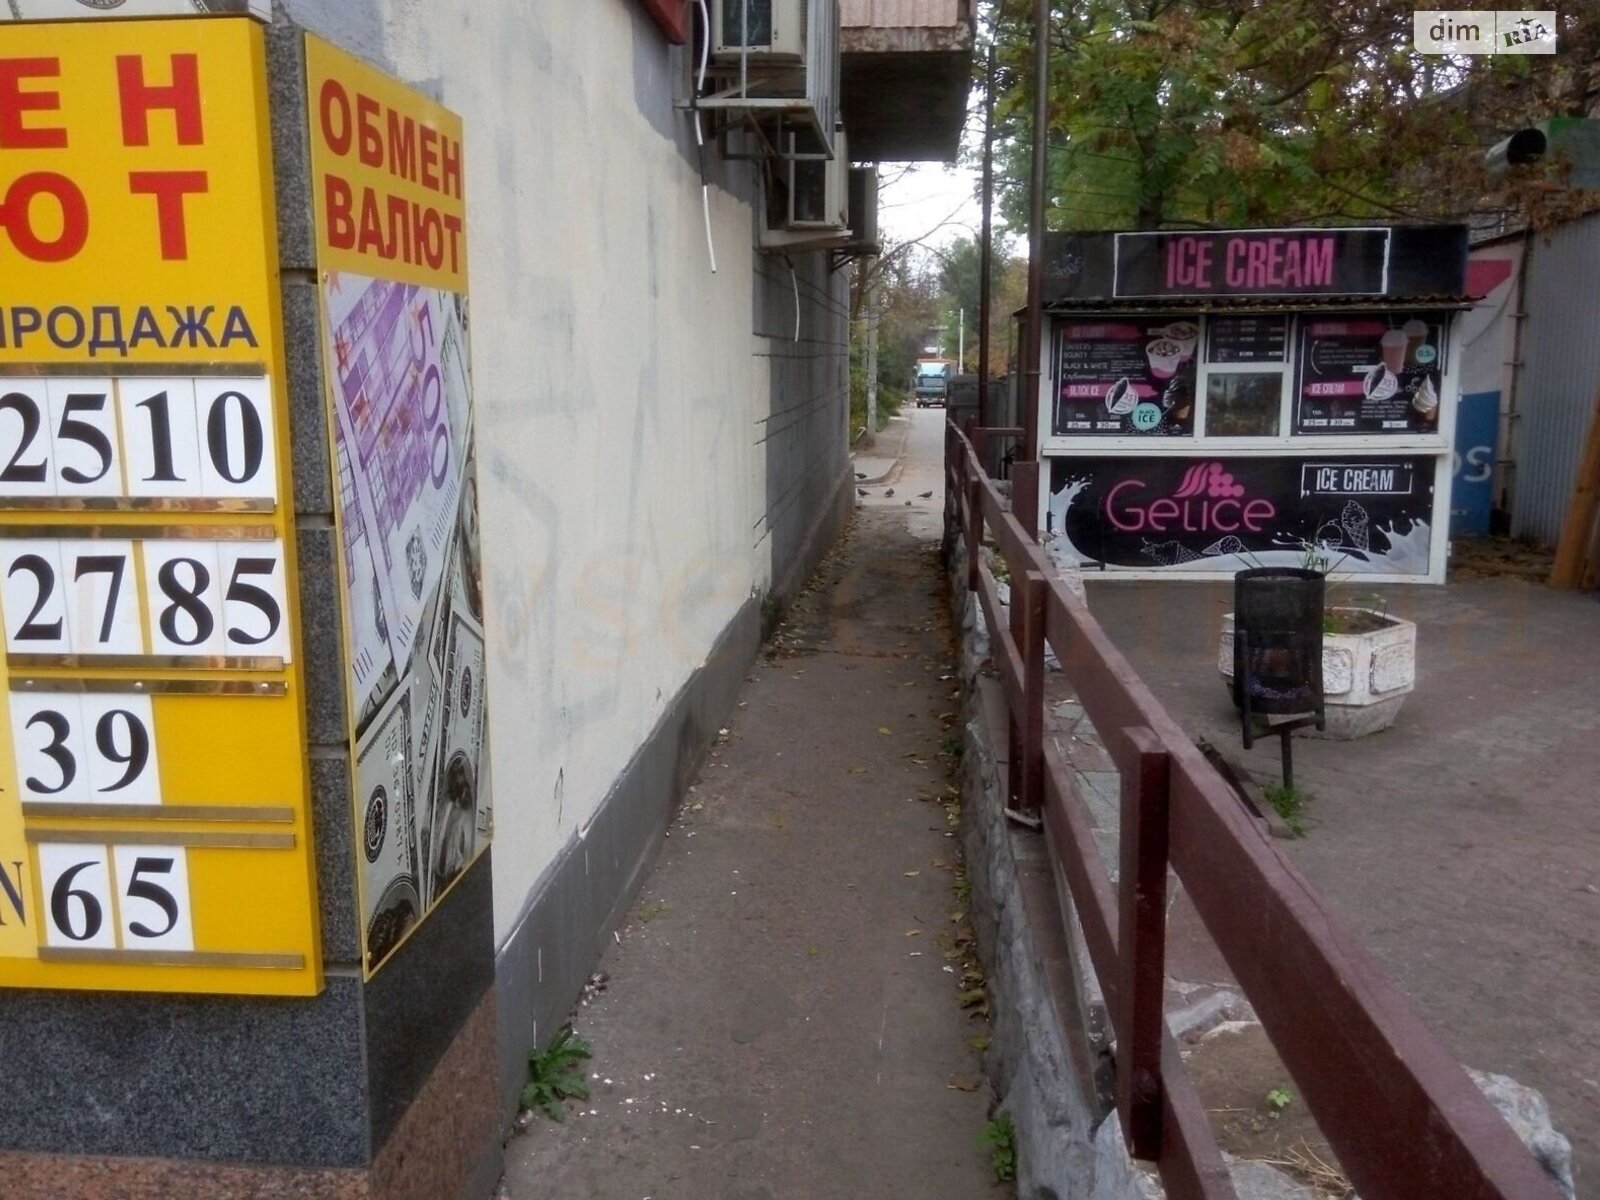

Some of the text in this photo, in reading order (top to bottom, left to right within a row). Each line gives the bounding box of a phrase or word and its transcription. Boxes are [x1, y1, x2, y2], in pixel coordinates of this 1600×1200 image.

[319, 78, 462, 200] ОБМЕН
[324, 174, 462, 274] ВАЛЮТ
[1166, 237, 1334, 288] ICE CREAM
[0, 305, 259, 357] РОДАЖА
[1138, 414, 1155, 423] ICE
[1316, 467, 1394, 491] ICE CREAM
[25, 709, 149, 794] 39
[50, 857, 179, 941] 65
